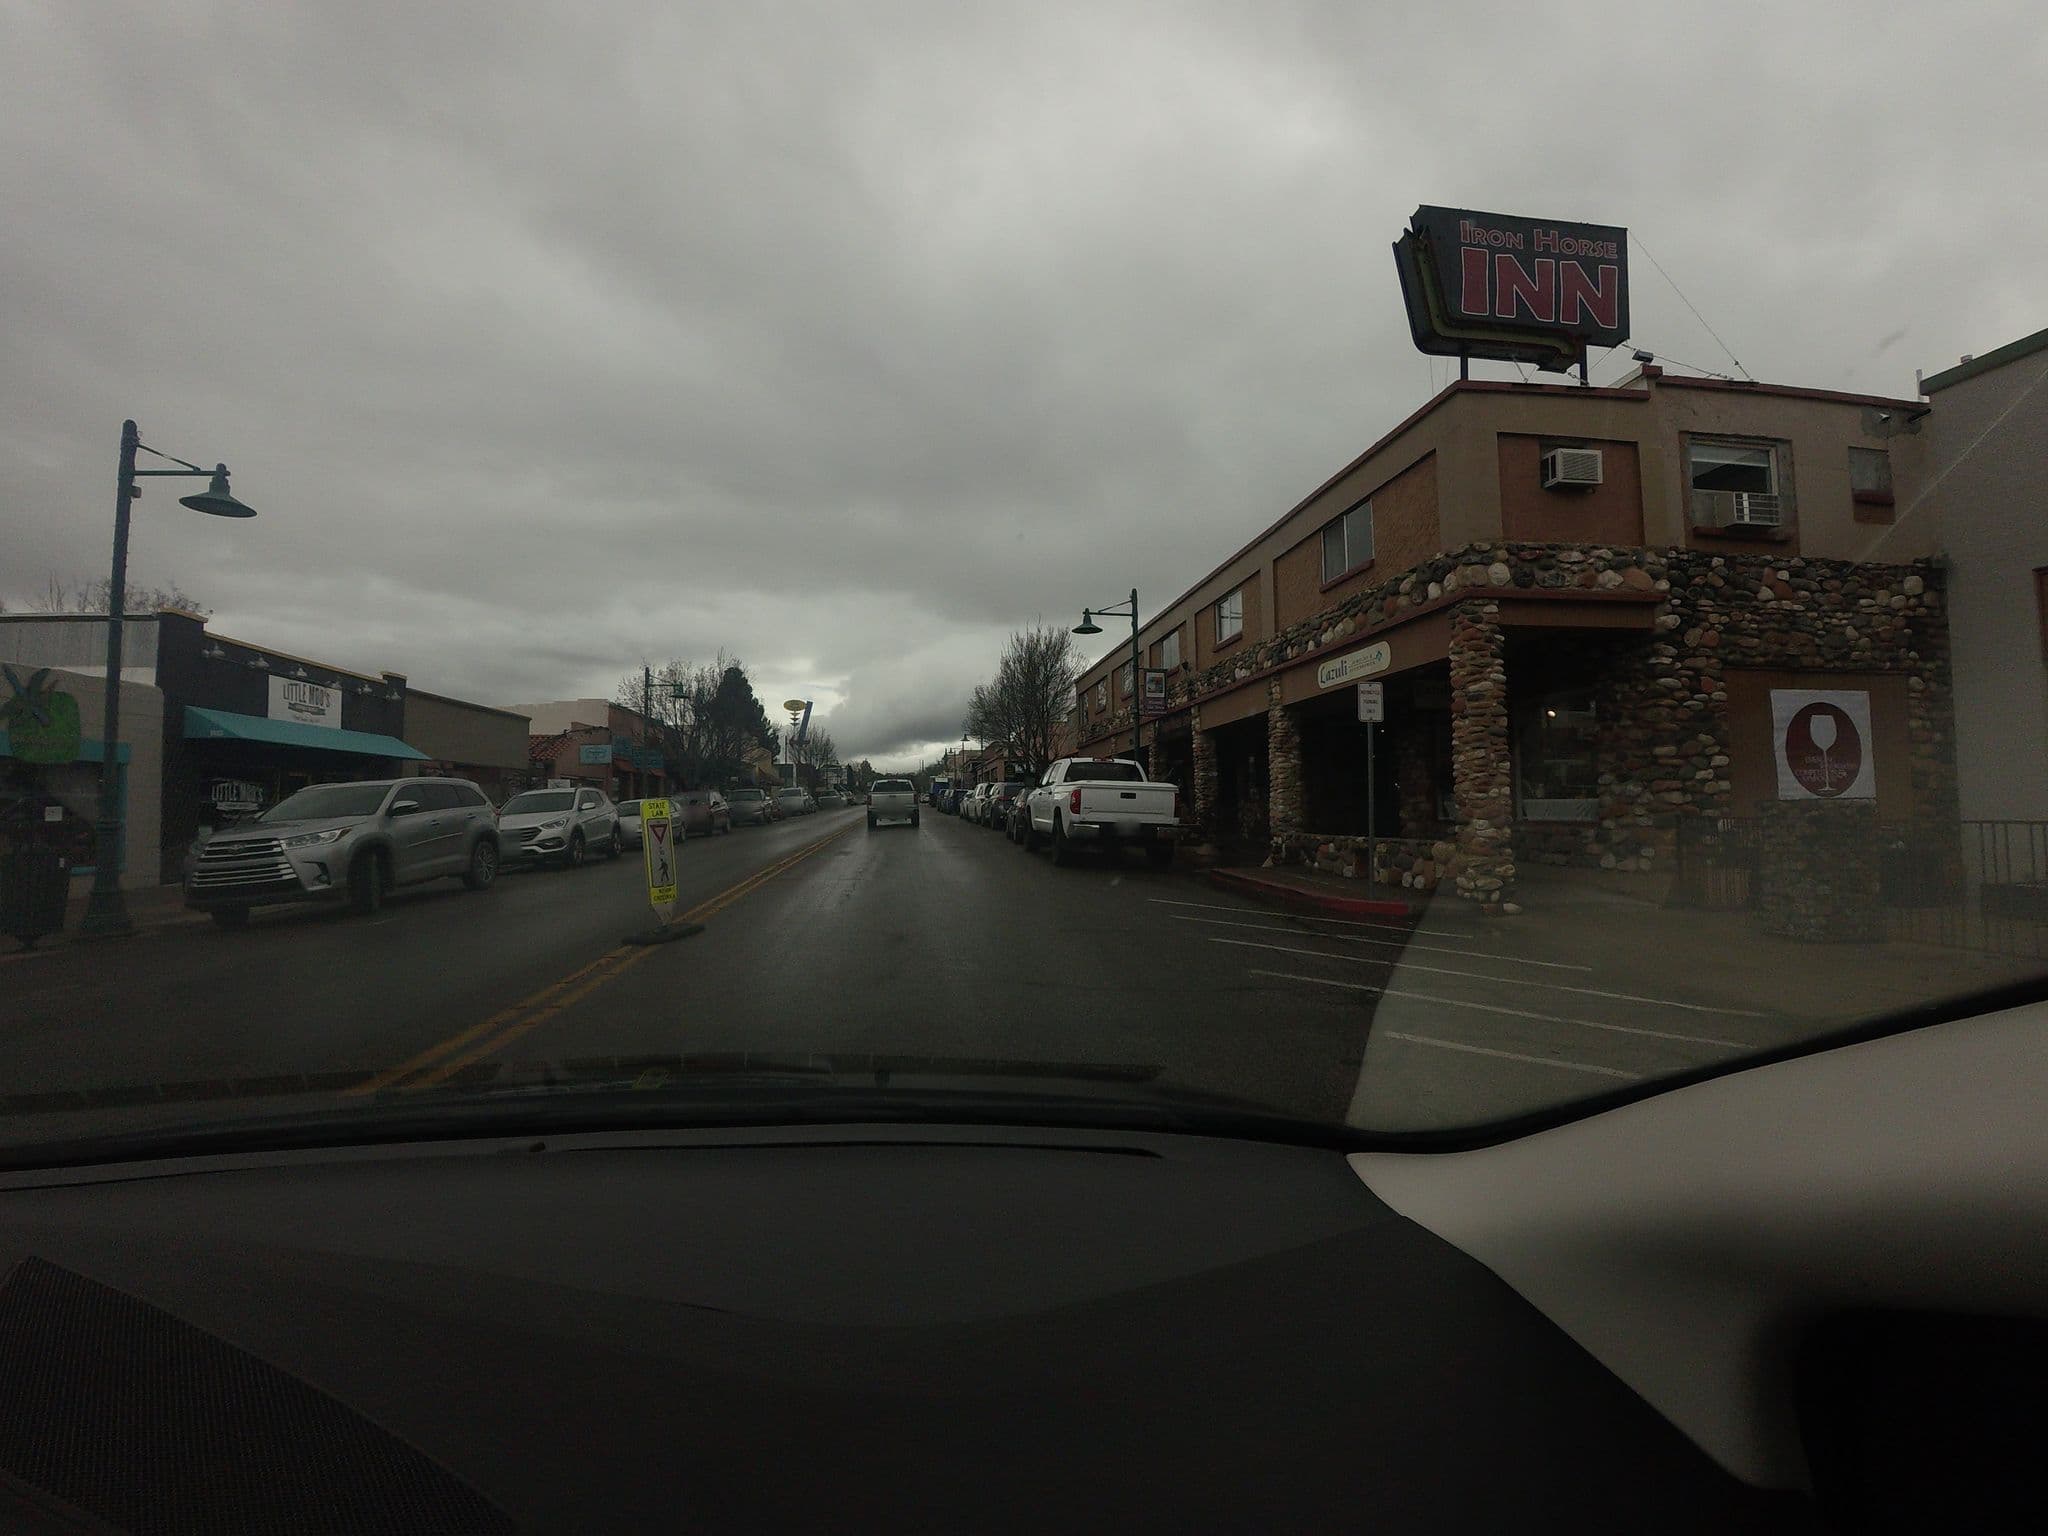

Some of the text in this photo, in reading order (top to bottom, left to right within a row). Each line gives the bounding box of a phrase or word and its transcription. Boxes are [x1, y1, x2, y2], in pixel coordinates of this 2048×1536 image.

[1459, 219, 1618, 259] IRON HORSE
[1460, 246, 1618, 330] INN
[1320, 660, 1348, 684] Lazuli
[282, 682, 307, 704] LITTLE
[211, 783, 238, 802] LITTLE
[648, 802, 666, 810] STATE
